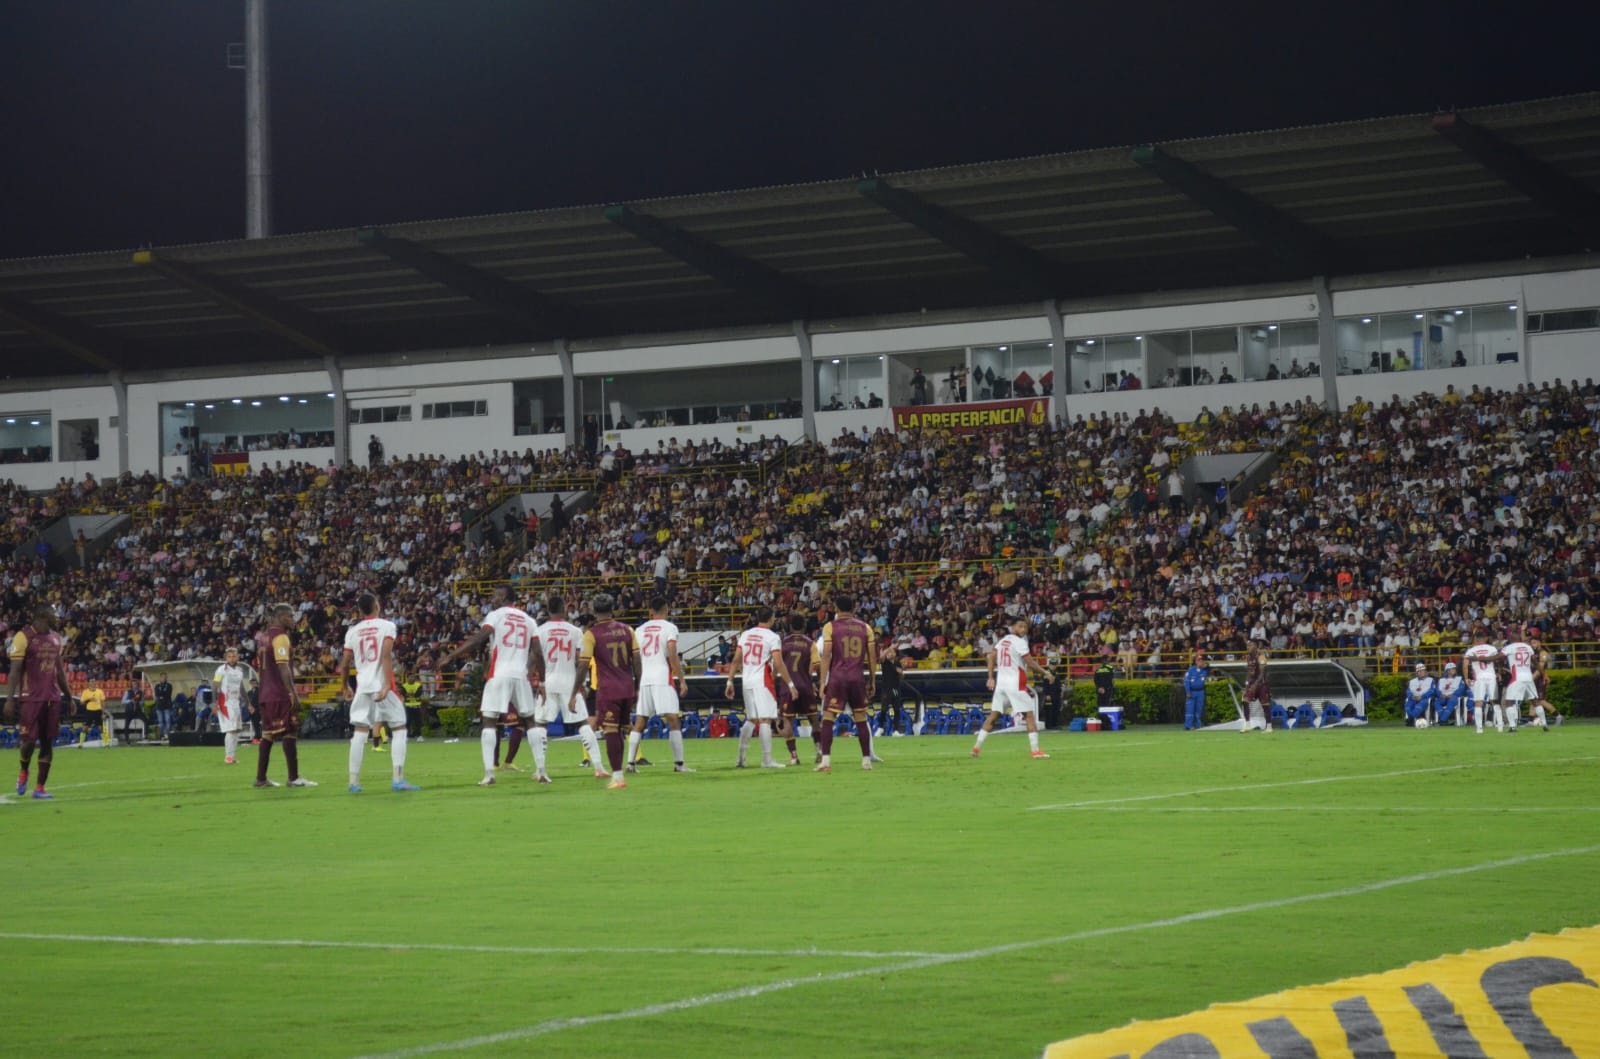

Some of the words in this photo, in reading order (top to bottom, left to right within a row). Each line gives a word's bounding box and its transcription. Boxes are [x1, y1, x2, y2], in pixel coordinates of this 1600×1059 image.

[898, 413, 920, 429] LA
[922, 407, 1025, 428] PREFERENCIA
[502, 621, 529, 649] 23
[642, 633, 660, 658] 21
[359, 636, 379, 663] 13
[547, 637, 573, 663] 24
[606, 640, 628, 668] 71
[743, 643, 764, 665] 29
[840, 636, 863, 658] 19
[790, 651, 802, 673] 7
[1514, 652, 1530, 668] 92
